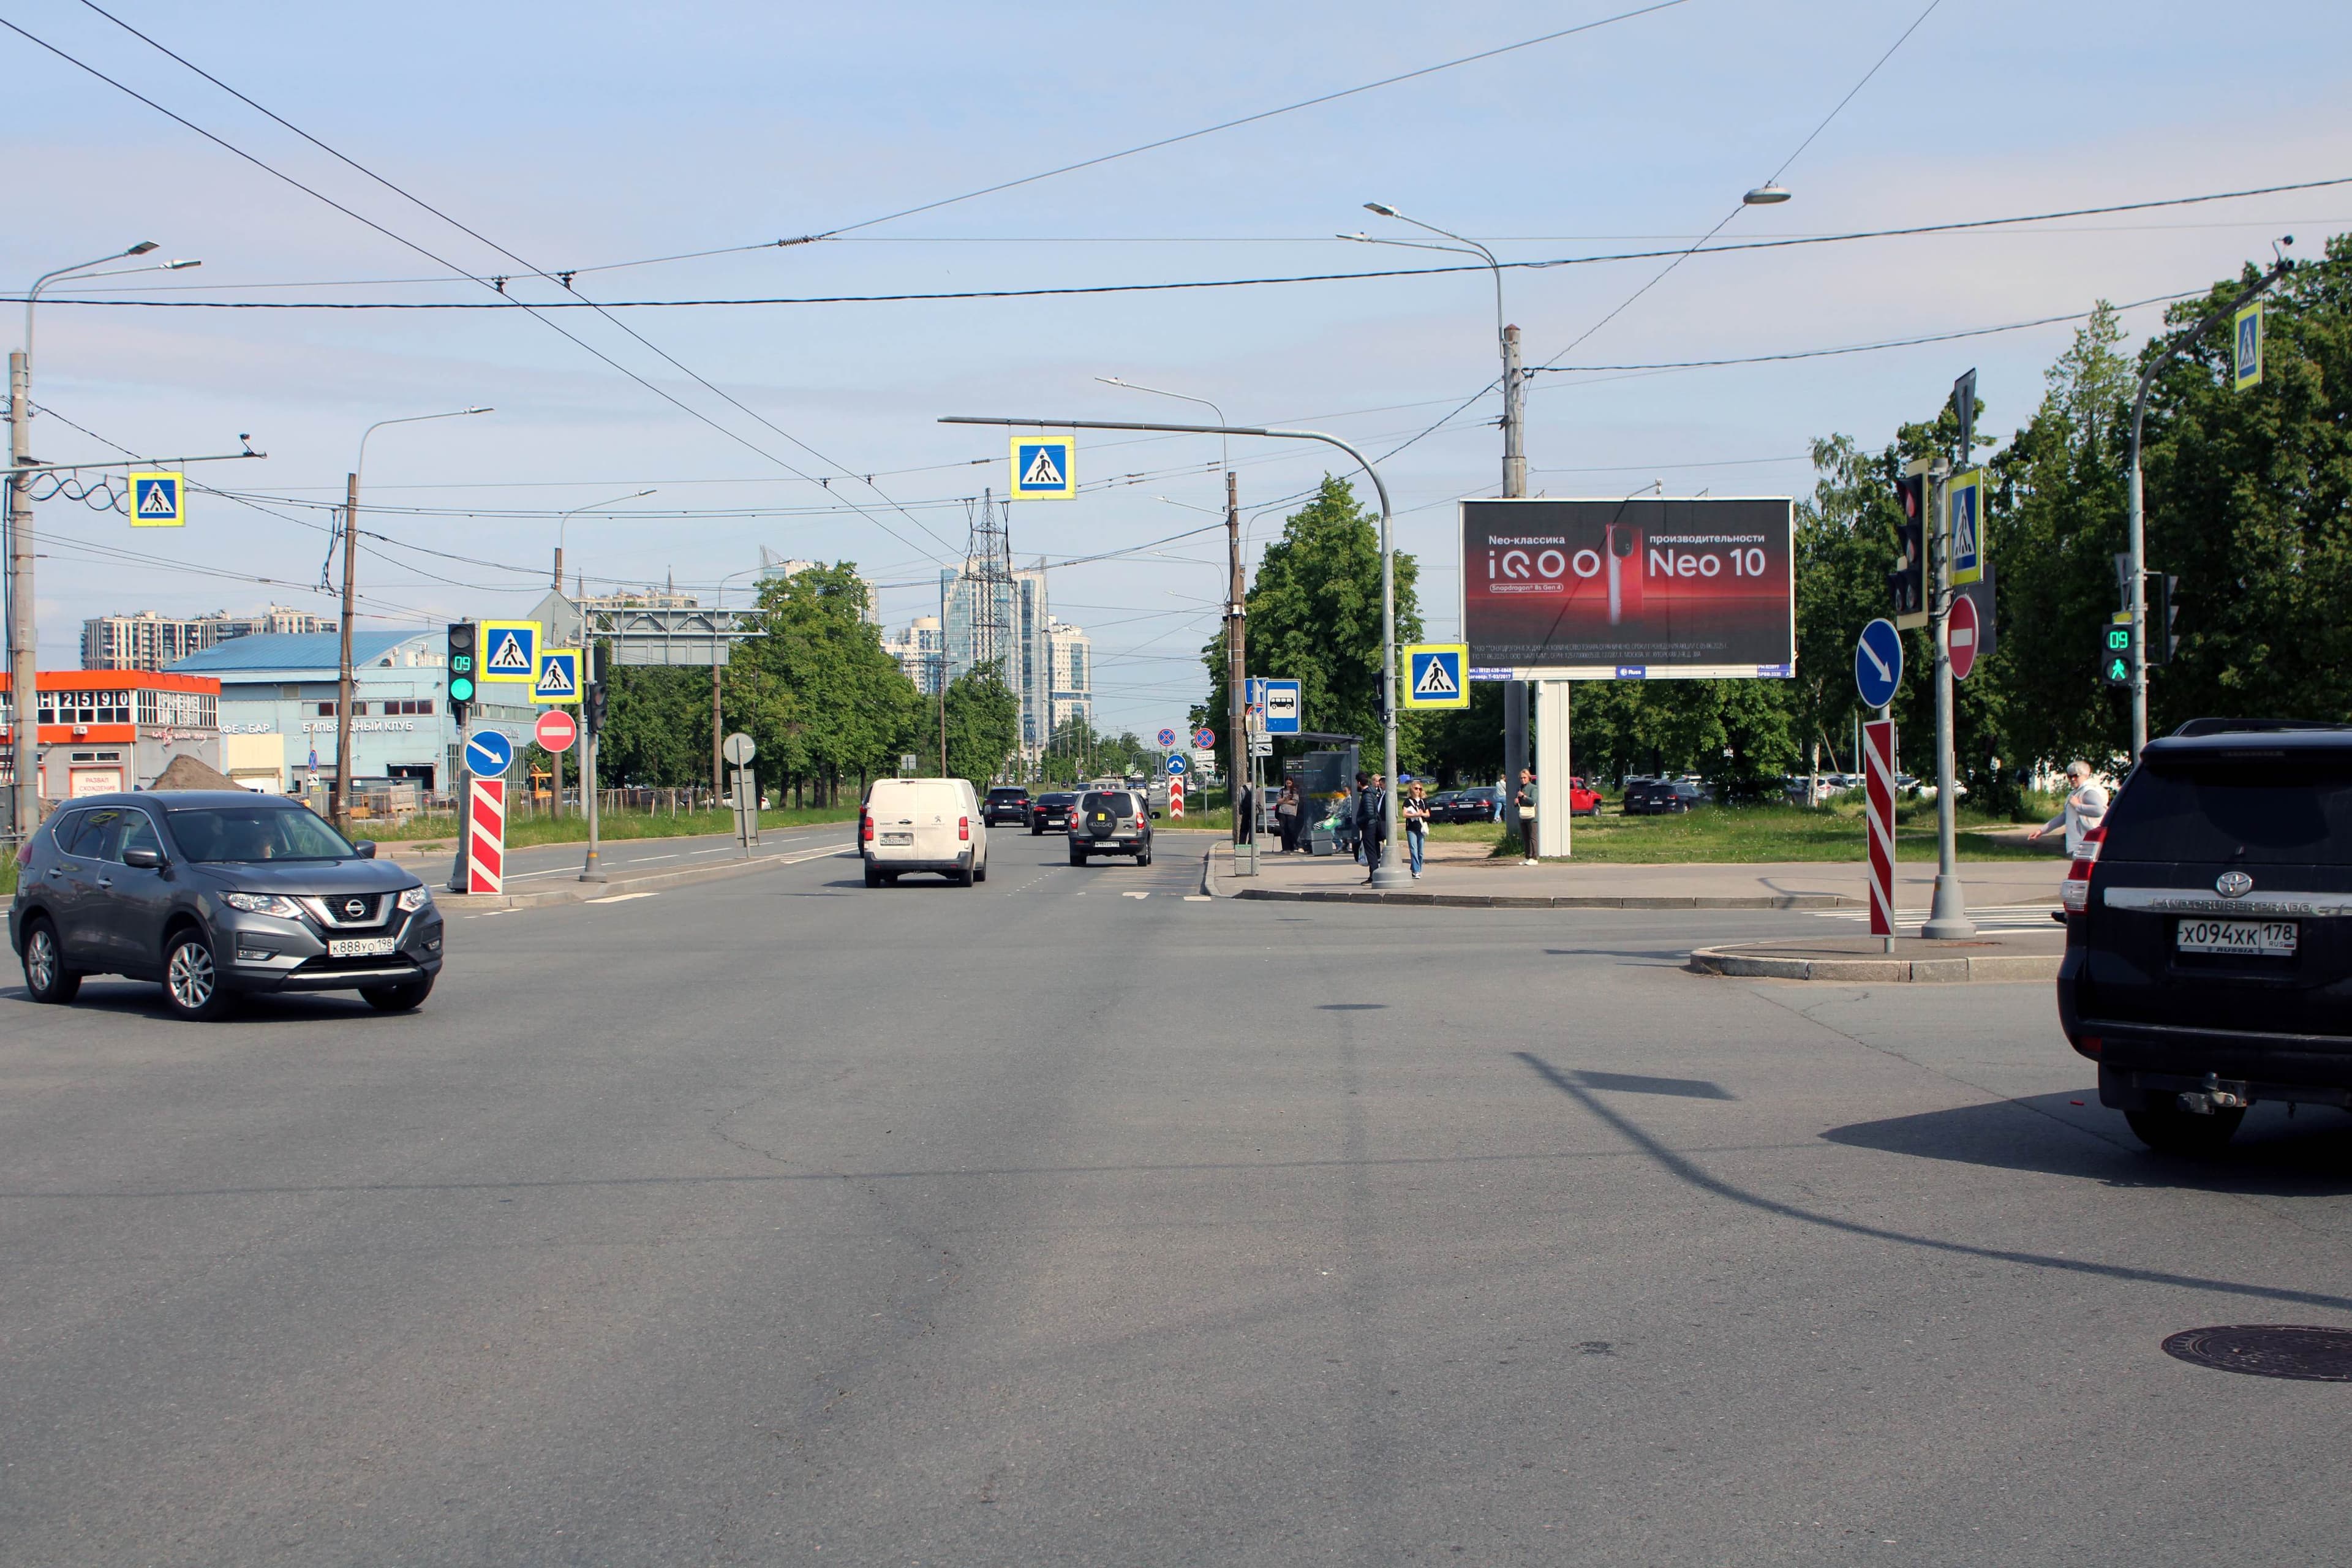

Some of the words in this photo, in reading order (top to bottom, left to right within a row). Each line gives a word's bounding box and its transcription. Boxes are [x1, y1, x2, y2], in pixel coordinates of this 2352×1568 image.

[1488, 535, 1566, 545] Neo-классика
[1649, 535, 1765, 545] производительности
[1489, 549, 1600, 579] iQOO
[1649, 549, 1721, 577] Neo
[1729, 548, 1766, 576] 10
[2109, 631, 2128, 649] 09
[454, 656, 470, 671] 09
[63, 692, 128, 707] 2590
[217, 725, 239, 734] АФЕ
[247, 723, 270, 734] БАР
[303, 720, 382, 733] БИЛЬЯДНЫЙ
[385, 721, 413, 732] КЛУБ
[2152, 898, 2188, 909] LAND
[2192, 899, 2256, 911] CRUISER
[2260, 901, 2312, 913] PRADO
[2184, 924, 2258, 945] Х094ХК
[2263, 924, 2293, 941] 178
[332, 940, 375, 953] К888УО
[377, 938, 393, 948] 198
